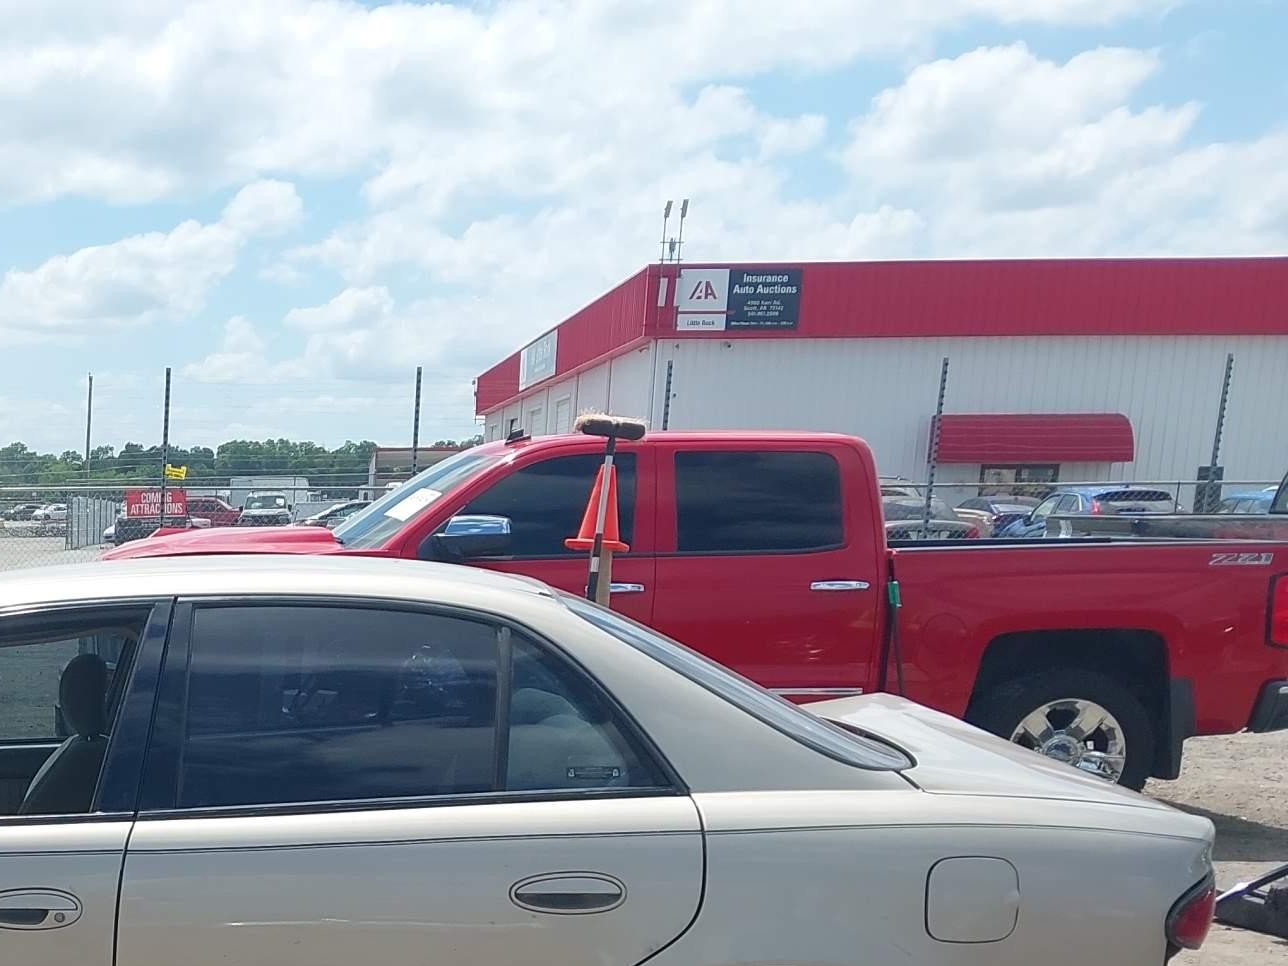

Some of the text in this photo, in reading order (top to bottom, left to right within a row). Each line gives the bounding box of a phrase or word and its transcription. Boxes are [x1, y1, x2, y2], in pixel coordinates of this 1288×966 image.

[743, 273, 789, 282] Insurance
[733, 284, 798, 294] Auto Auctions
[130, 502, 183, 514] ATTRACIONS
